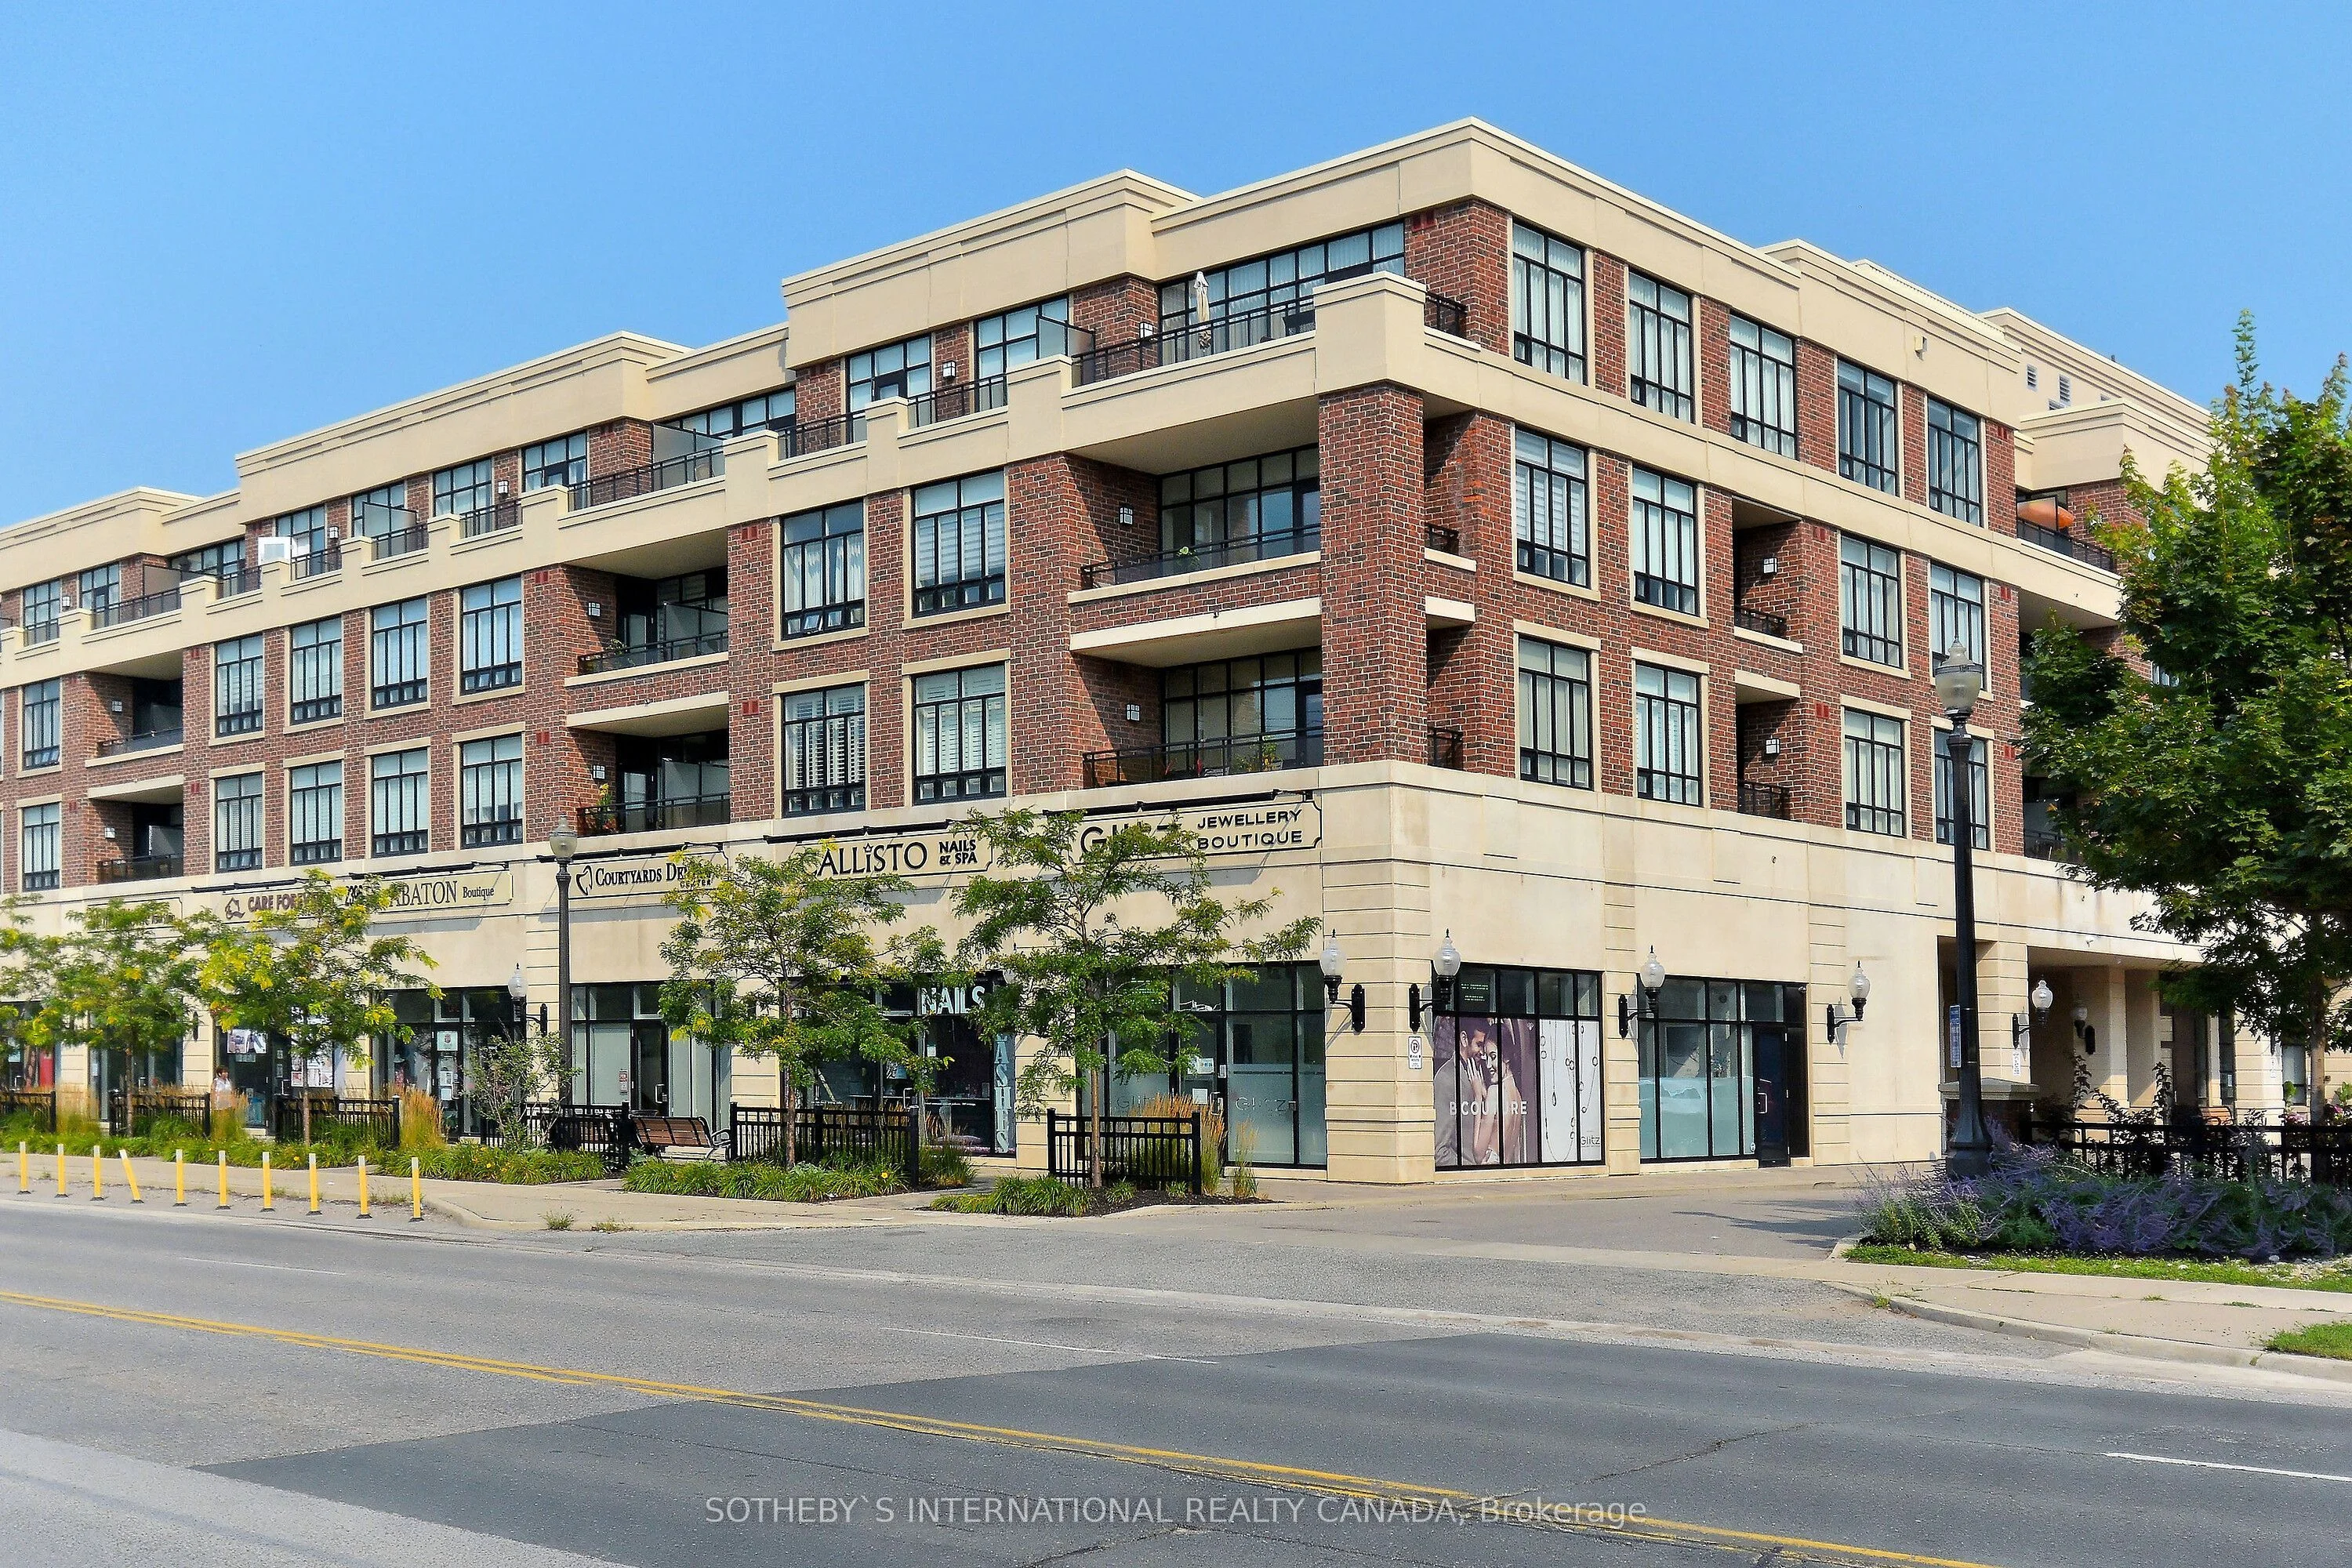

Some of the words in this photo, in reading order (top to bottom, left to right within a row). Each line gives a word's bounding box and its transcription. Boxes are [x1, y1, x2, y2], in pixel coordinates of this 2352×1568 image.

[1197, 809, 1303, 829] JEWELLERY
[938, 839, 977, 854] NAILS
[1197, 830, 1303, 849] BOUTIQUE
[939, 855, 952, 866] &
[955, 851, 978, 865] SPA
[595, 867, 662, 886] COURTYARDS
[463, 886, 495, 901] Boutique
[248, 895, 274, 913] CARE
[920, 985, 986, 1014] NAILS
